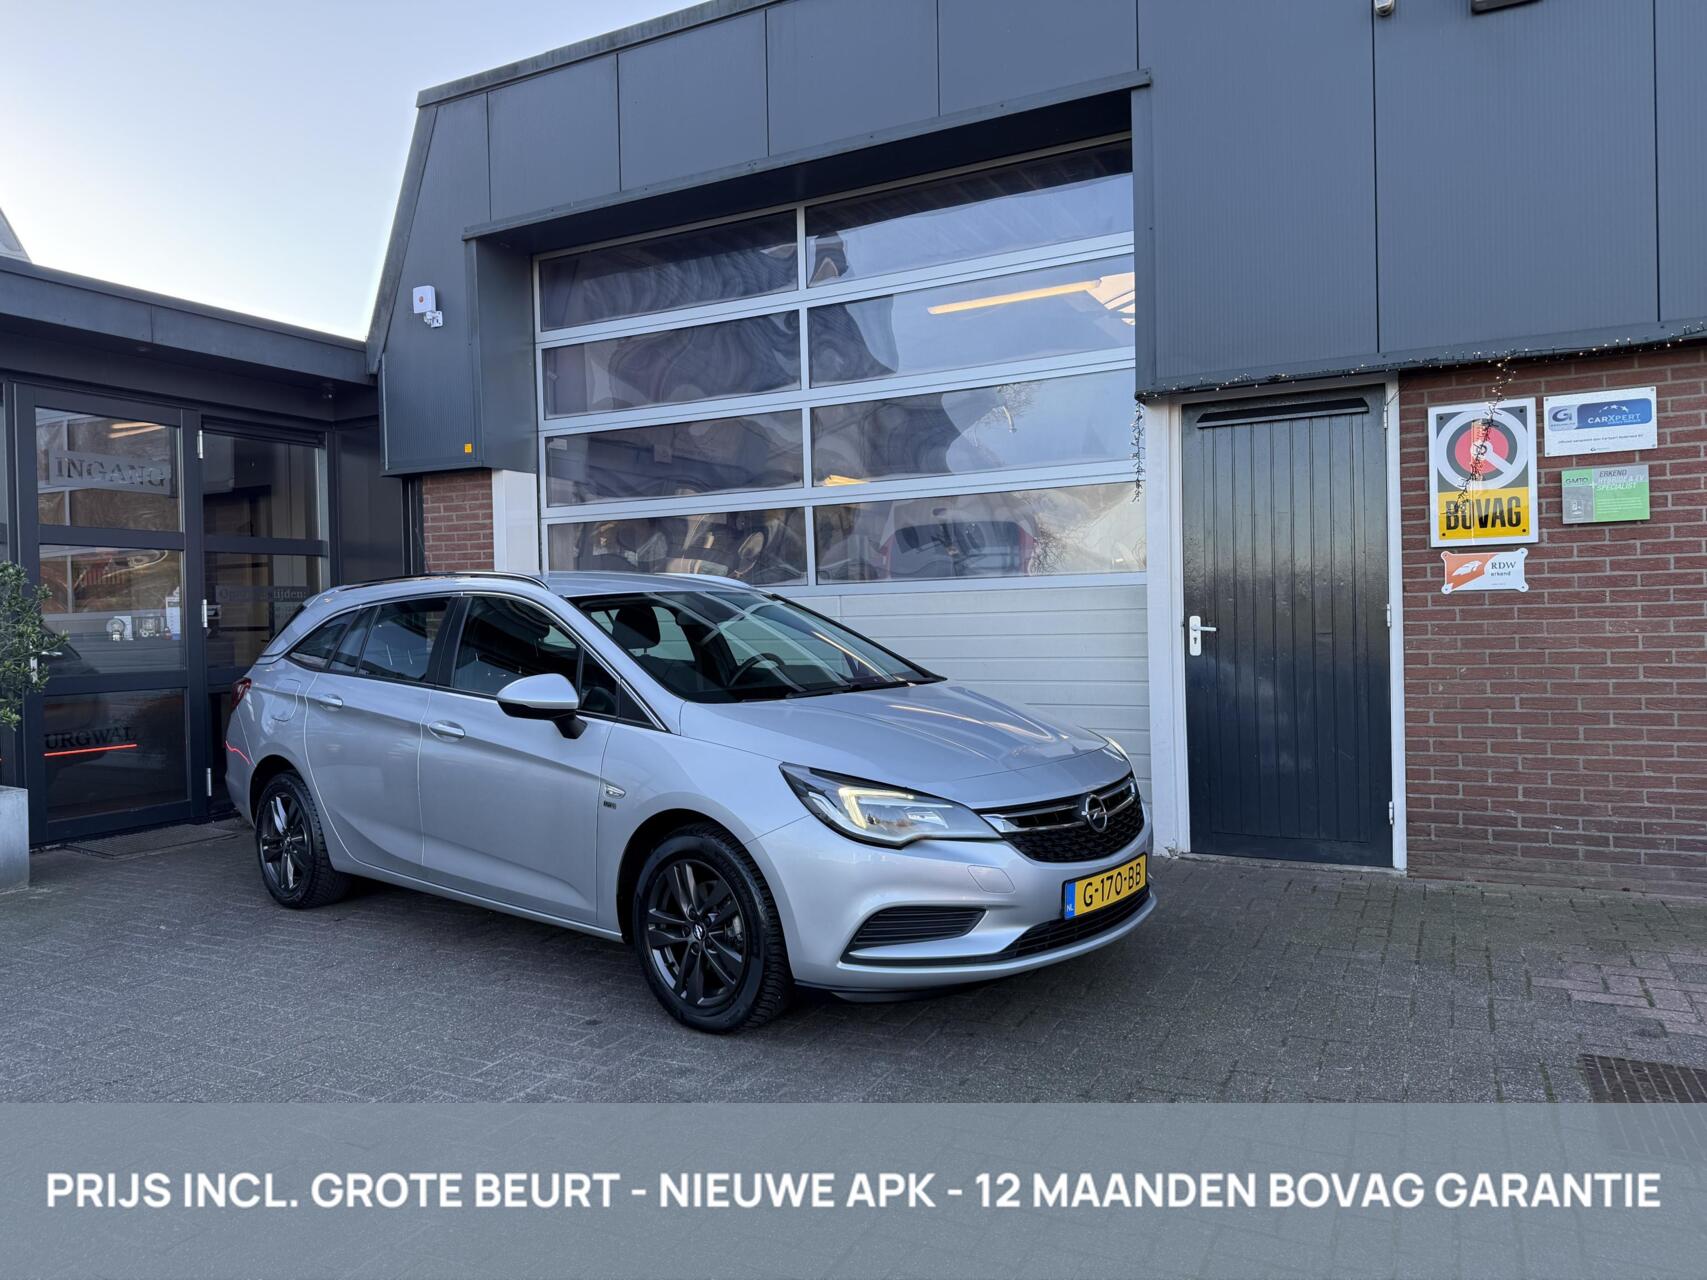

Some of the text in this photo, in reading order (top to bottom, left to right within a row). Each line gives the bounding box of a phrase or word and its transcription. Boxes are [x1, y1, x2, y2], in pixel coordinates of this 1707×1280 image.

[54, 455, 165, 487] INGANG
[1445, 495, 1522, 530] BOVAG
[1491, 561, 1517, 570] RDW
[1083, 862, 1142, 907] G-170-BB
[1066, 904, 1075, 912] NL
